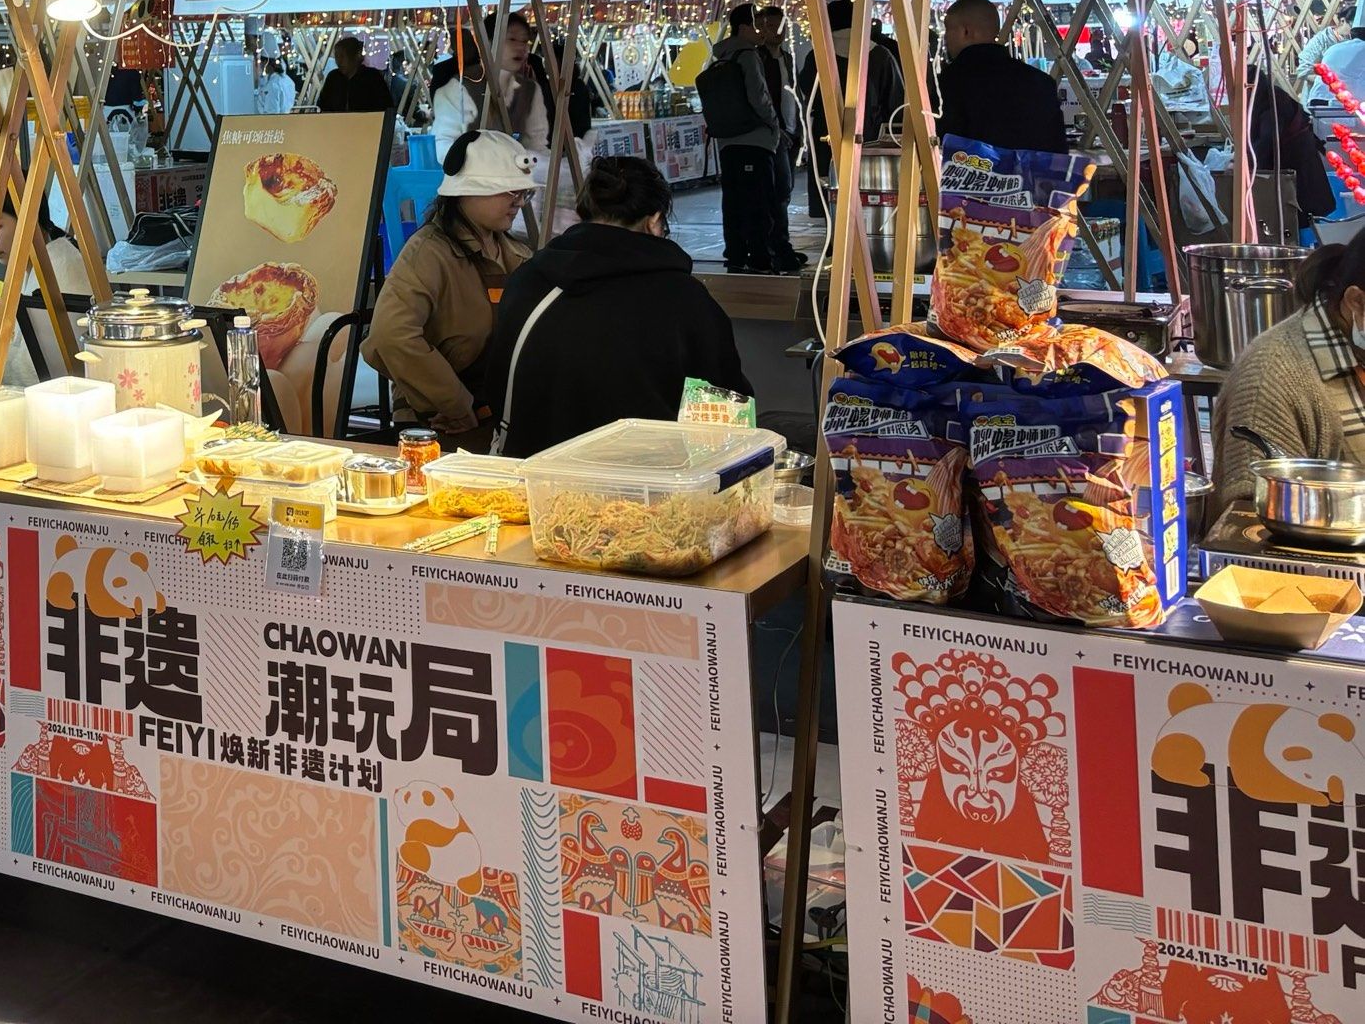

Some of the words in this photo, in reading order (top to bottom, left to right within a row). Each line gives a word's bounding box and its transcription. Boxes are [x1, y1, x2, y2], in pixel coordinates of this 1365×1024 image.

[27, 516, 109, 536] FEIYICHAOWANJU
[411, 565, 519, 589] FEIYICHAOWANJU
[565, 583, 683, 610] FEIYICHAOWANJU
[46, 592, 203, 724] 非遗
[265, 641, 498, 777] 潮玩局
[263, 621, 408, 670] CHAOWAN
[705, 621, 722, 733] FEIYICHAOWANJU
[902, 622, 1048, 657] FEIYICHAOWANJU
[1112, 652, 1275, 689] FEIYICHAOWANJU
[138, 714, 215, 761] FEIYI
[220, 731, 383, 794] 焕新非遗计划
[869, 640, 886, 755] FEIYICHAOWANJU
[878, 788, 894, 906] FEIYICHAOWANJU
[712, 764, 728, 877] FEIYICHAOWANJU
[32, 861, 116, 890] FEIYICHAOWANJU
[150, 891, 242, 924] FEIYICHAOWANJU
[280, 924, 380, 960] FEIYICHAOWANJU
[423, 960, 534, 1001] FEIYICHAOWANJU
[719, 910, 734, 1024] FEIYICHAOWANJU
[1157, 941, 1269, 977] 2024.11.13-11.16
